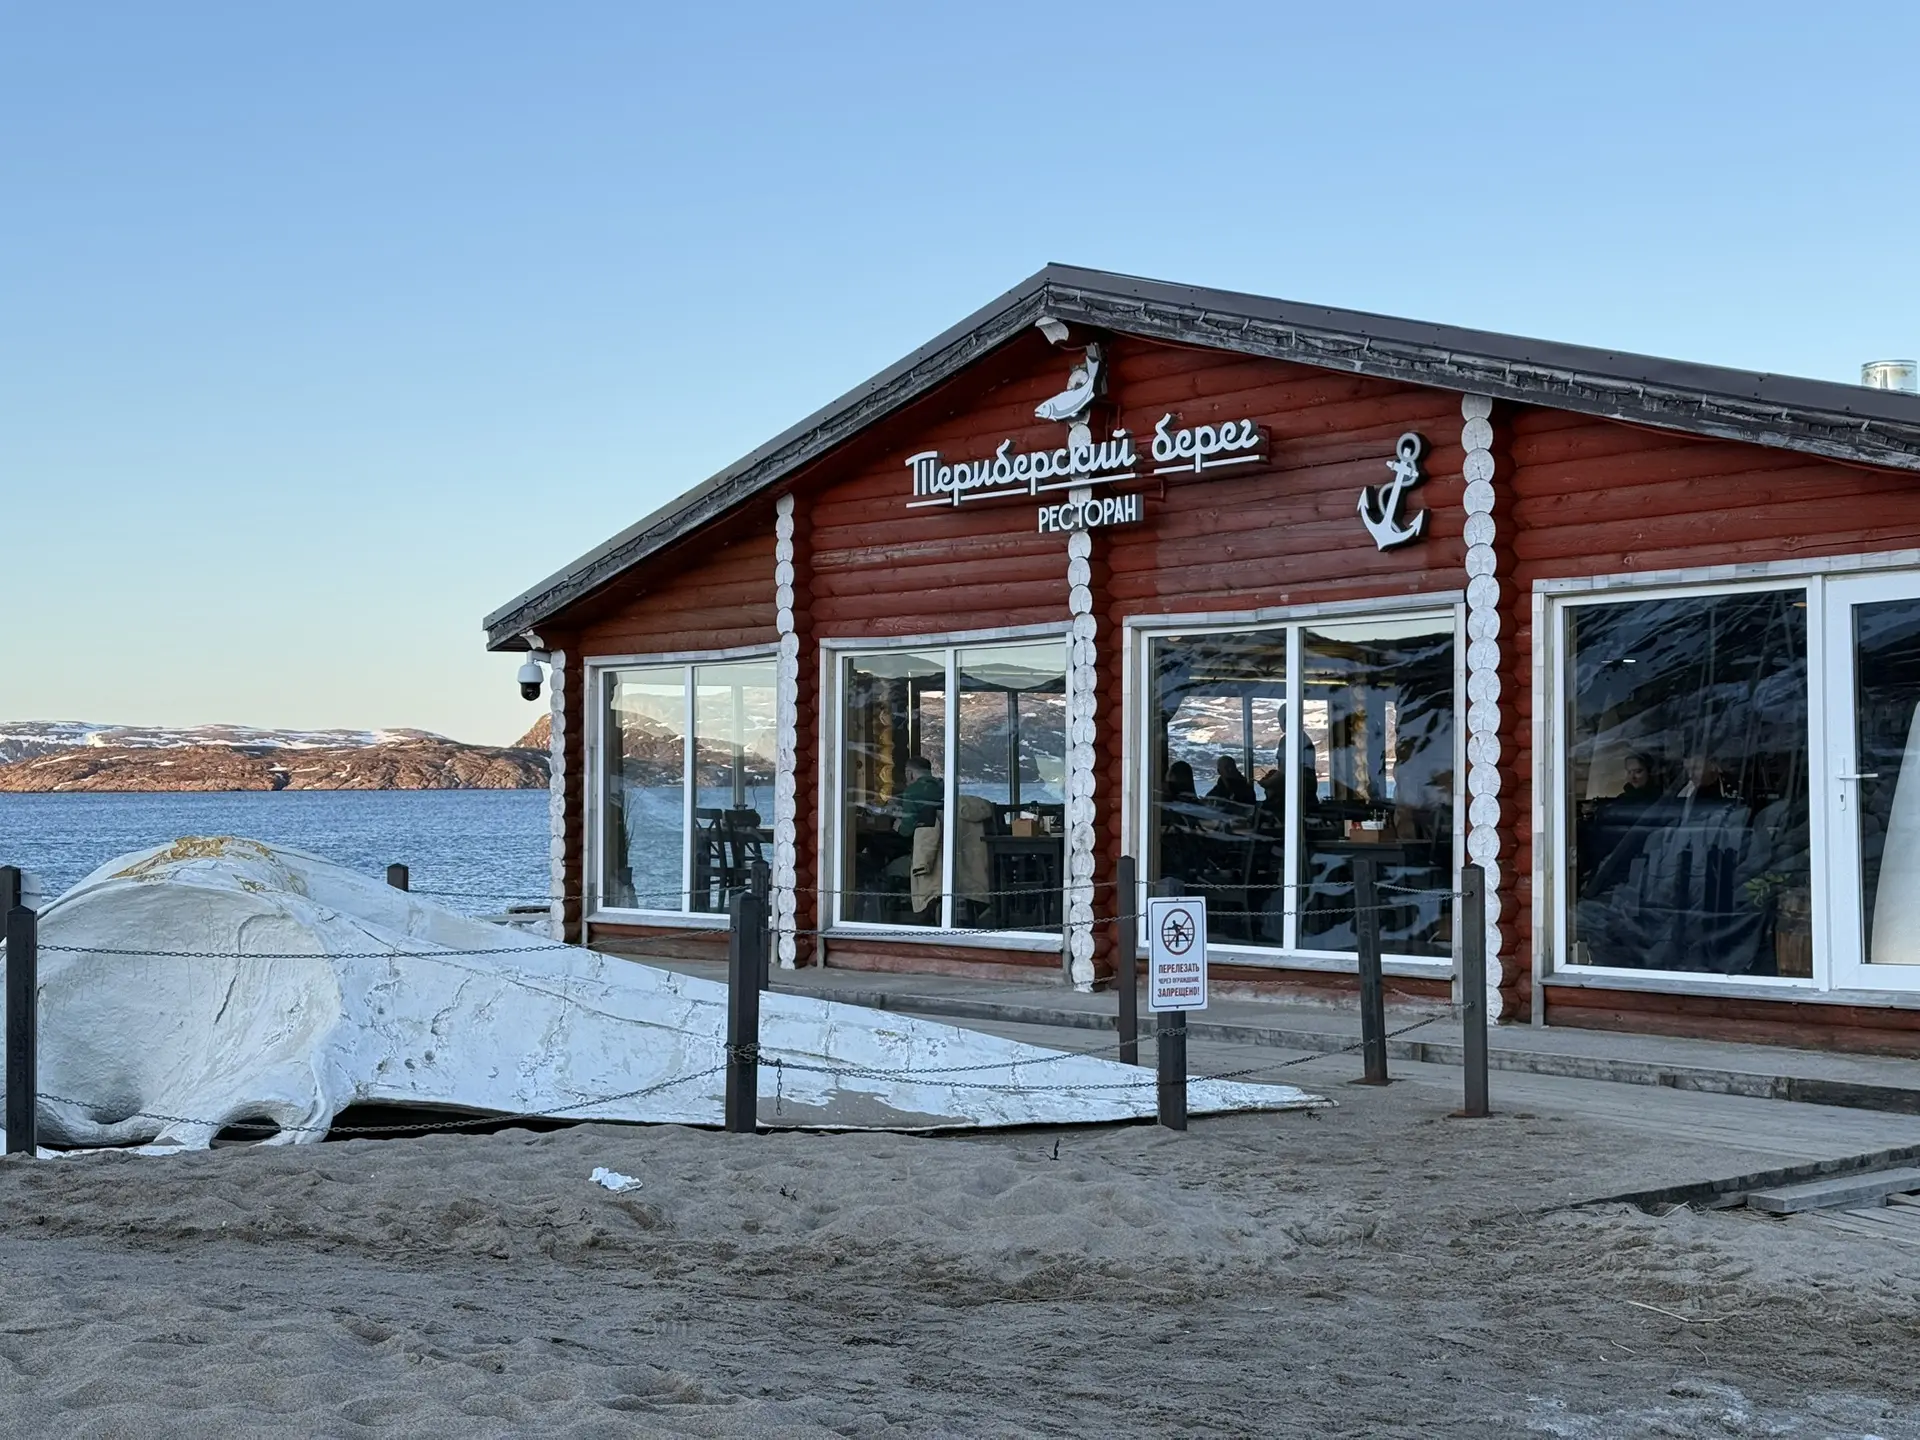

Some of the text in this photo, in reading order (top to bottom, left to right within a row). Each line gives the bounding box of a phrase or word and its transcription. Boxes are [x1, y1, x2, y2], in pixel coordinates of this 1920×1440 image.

[905, 413, 1259, 506] Териберский берег
[1038, 494, 1136, 533] РЕСТОРАН
[1158, 963, 1200, 974] ПЕРЕЛЕЗАТЬ
[1157, 986, 1200, 997] ЗАПРЕЩЕНО!
